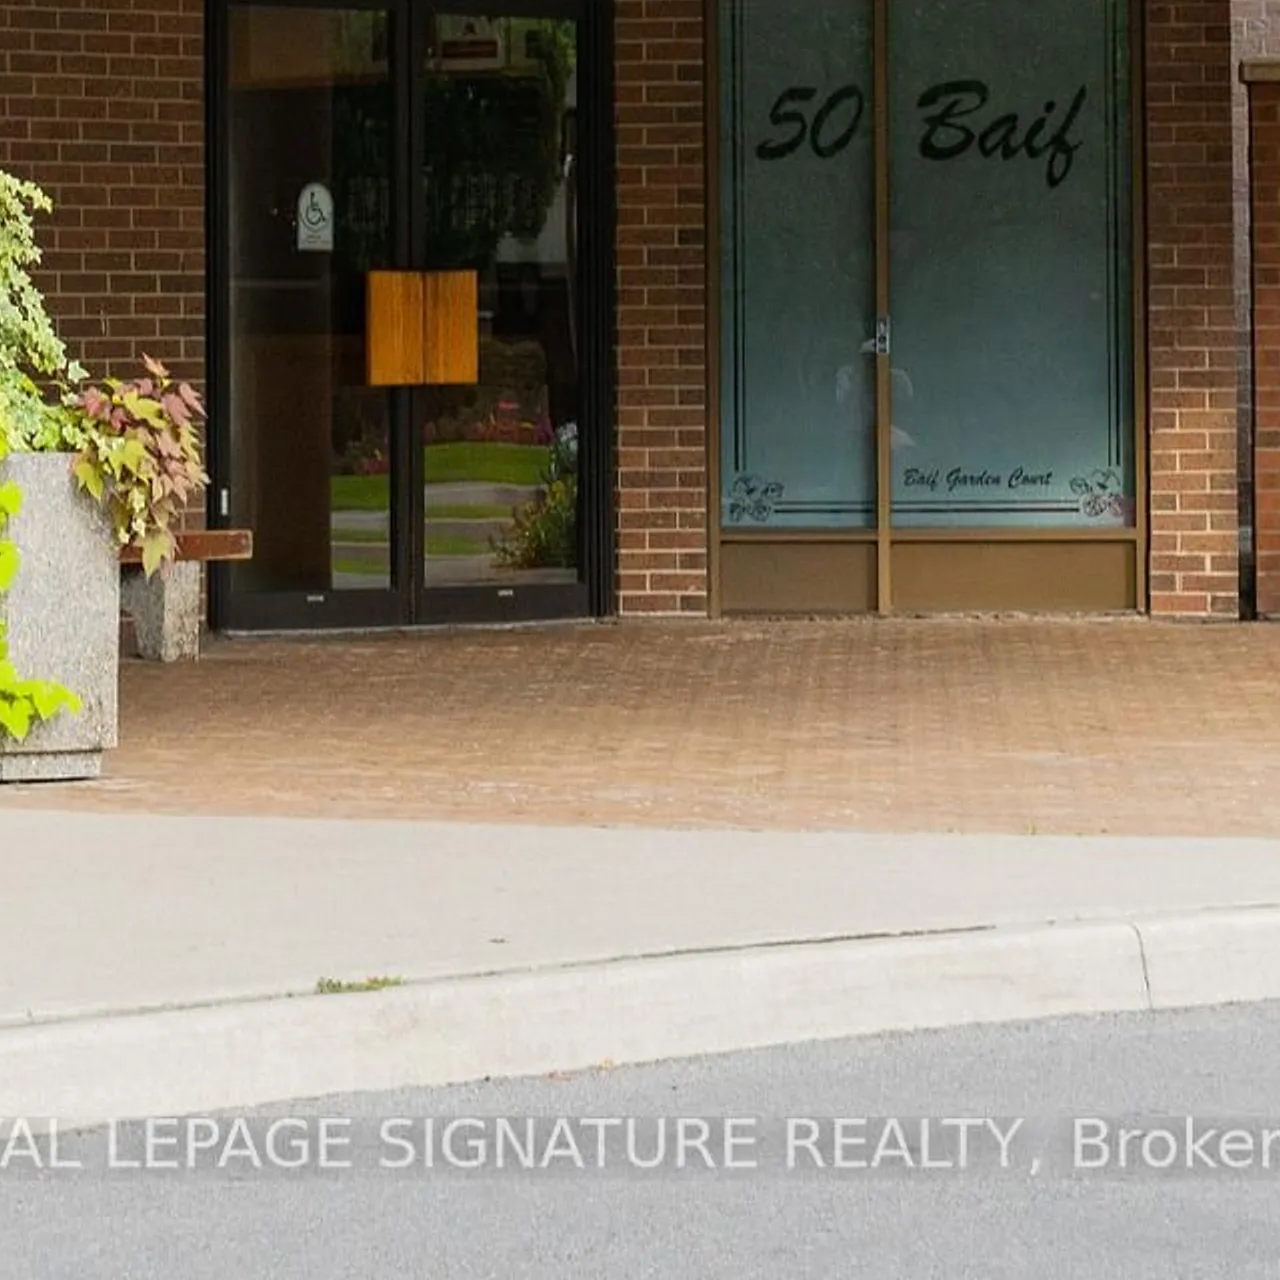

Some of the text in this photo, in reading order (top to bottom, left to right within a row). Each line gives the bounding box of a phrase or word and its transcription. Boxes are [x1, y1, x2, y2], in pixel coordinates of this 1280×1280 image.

[754, 79, 1087, 188] 50 Baif
[903, 465, 1053, 492] Baif Garden Court
